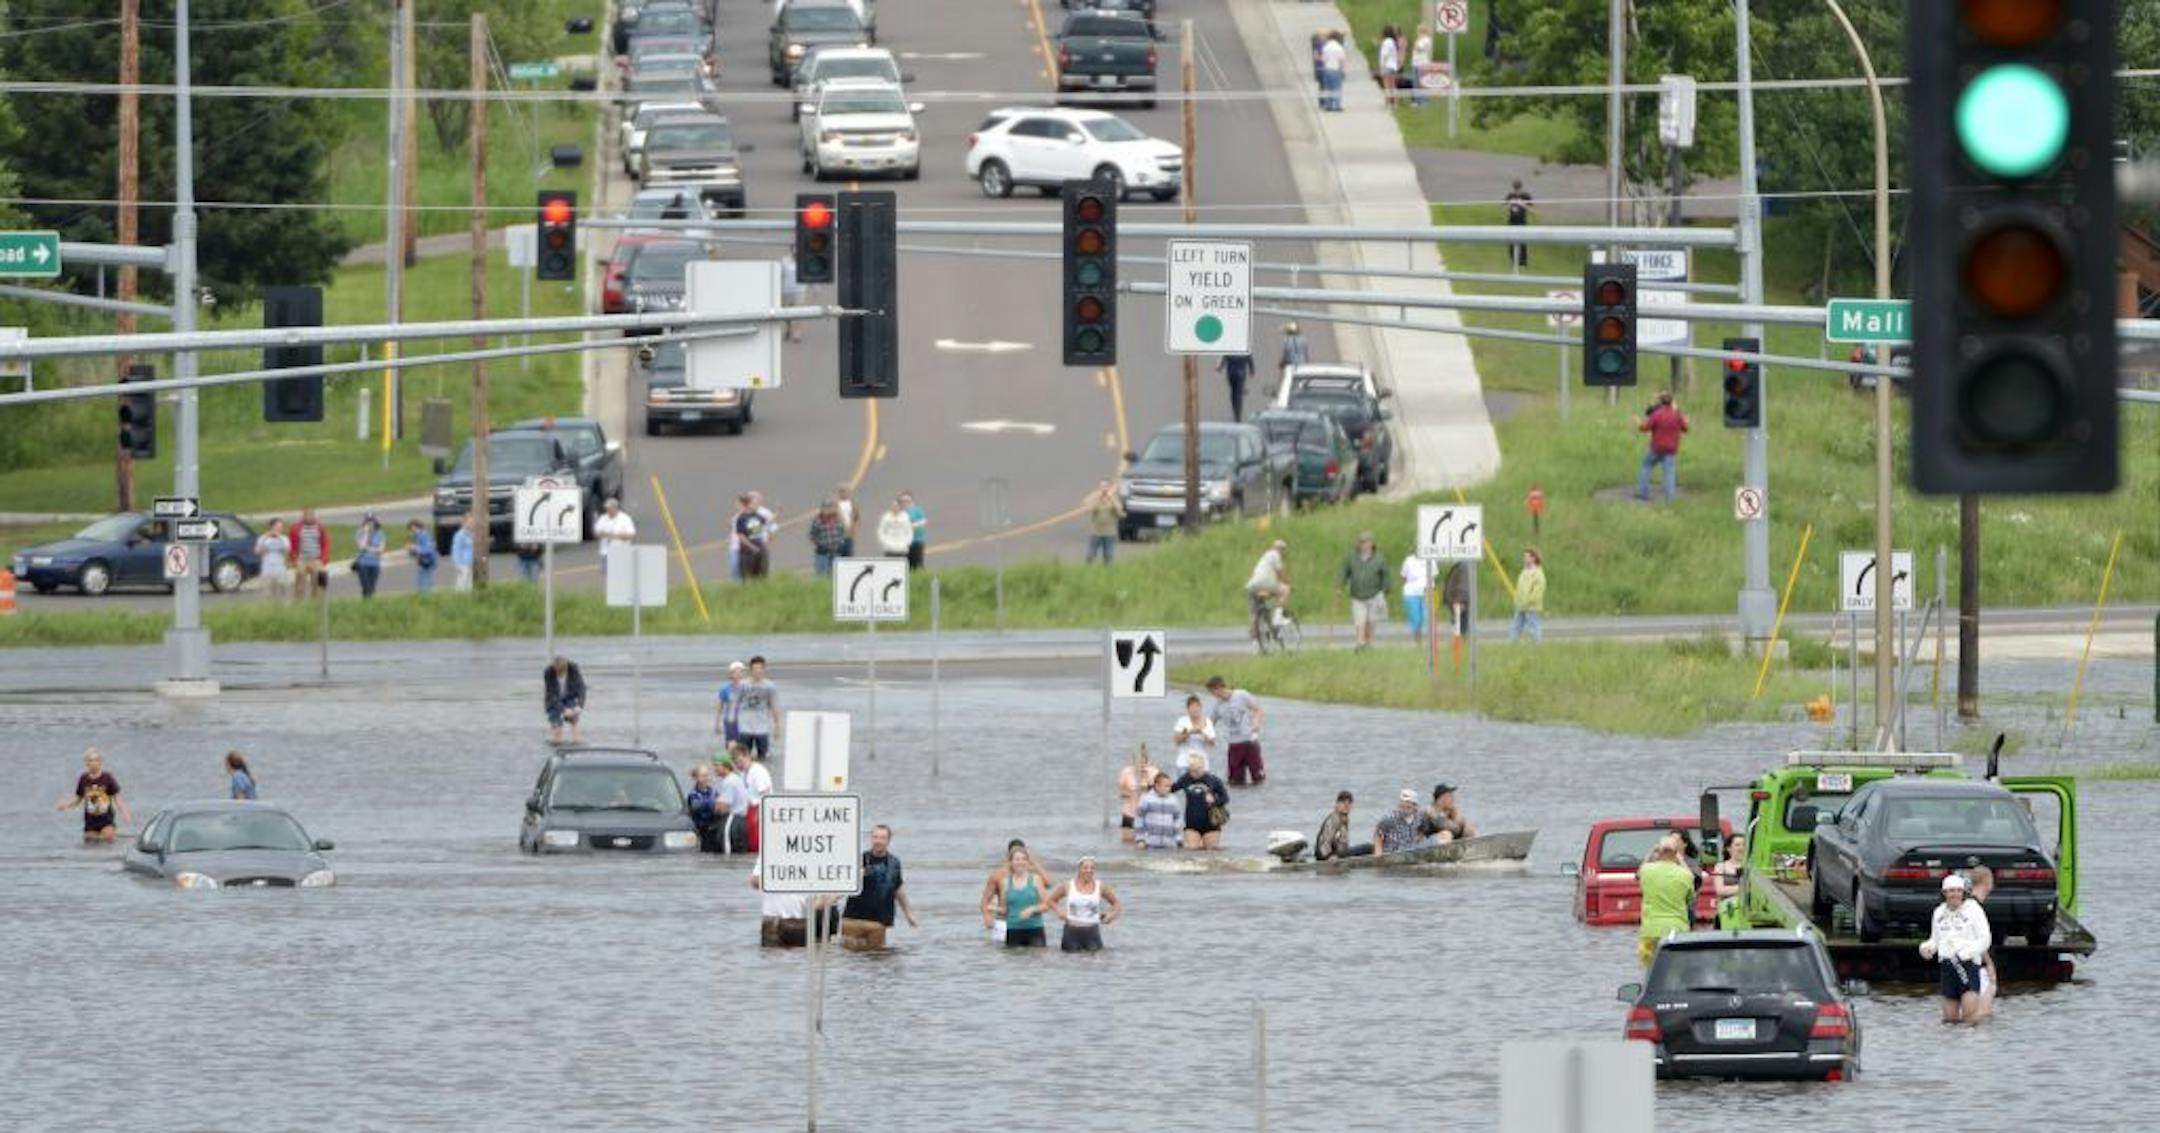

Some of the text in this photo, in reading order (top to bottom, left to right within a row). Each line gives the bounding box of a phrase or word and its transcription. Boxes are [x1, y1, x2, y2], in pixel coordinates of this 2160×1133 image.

[1174, 249, 1248, 264] LEFT TURN
[1189, 271, 1232, 288] YIELD
[1174, 295, 1245, 309] ON GREEN
[1843, 309, 1904, 333] Mall
[840, 603, 867, 615] ONLY
[1847, 596, 1874, 607] ONLY
[771, 807, 851, 823] LEFT LANE
[786, 834, 835, 854] MUST
[770, 864, 852, 881] TURN LEFT
